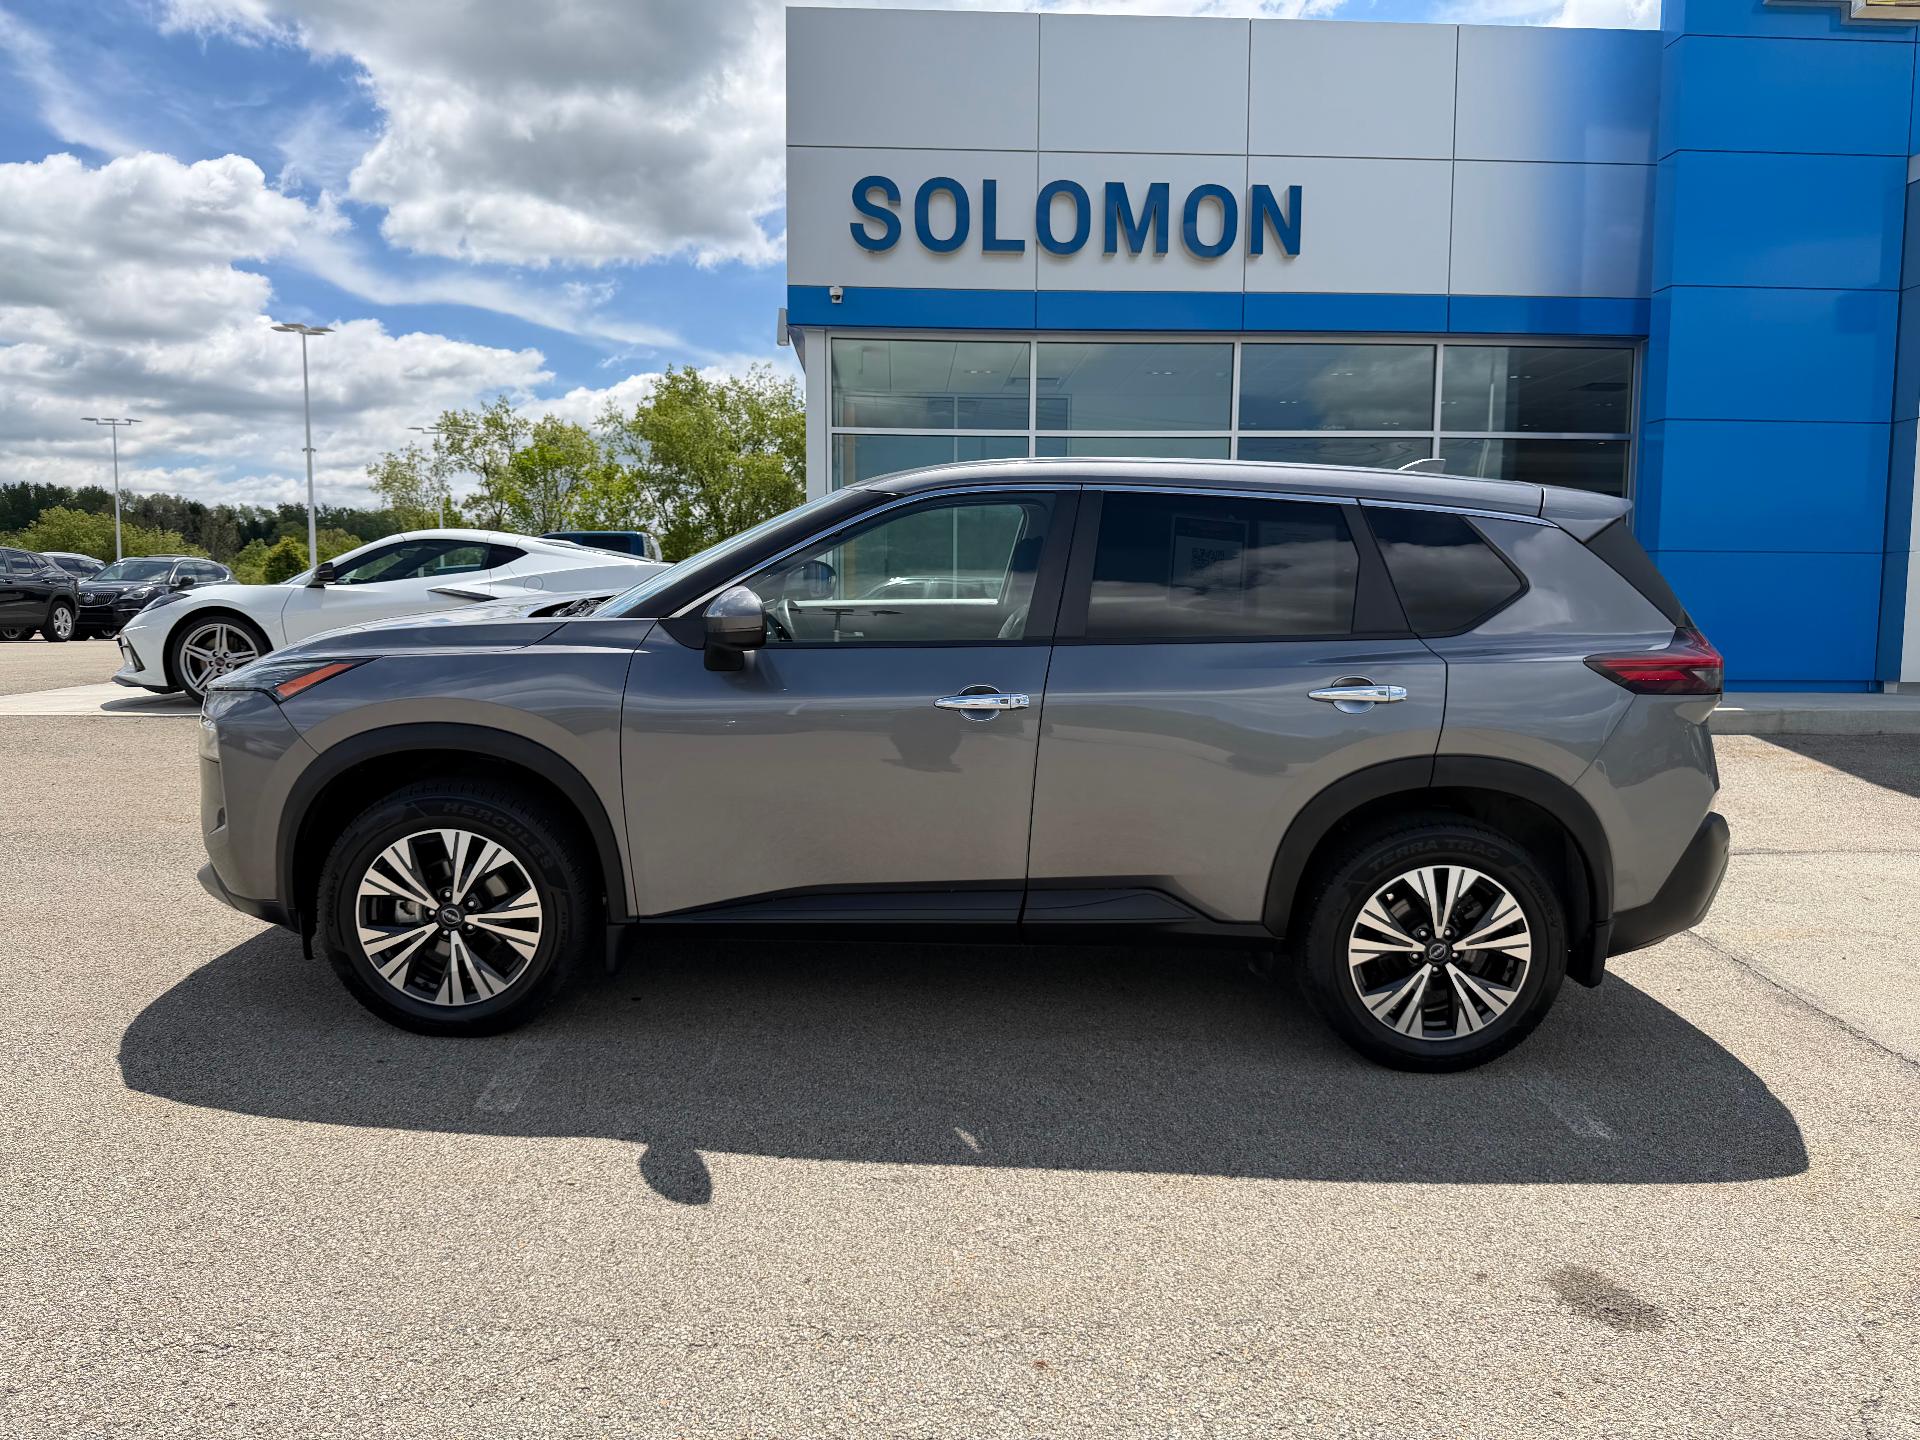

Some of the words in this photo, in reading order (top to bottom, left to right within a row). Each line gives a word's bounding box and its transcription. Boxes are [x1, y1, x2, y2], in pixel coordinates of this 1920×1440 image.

[849, 175, 1303, 259] SOLOMON
[441, 802, 558, 869] HERCULES
[1368, 840, 1439, 871] TERRA
[1445, 839, 1502, 859] TRAC
